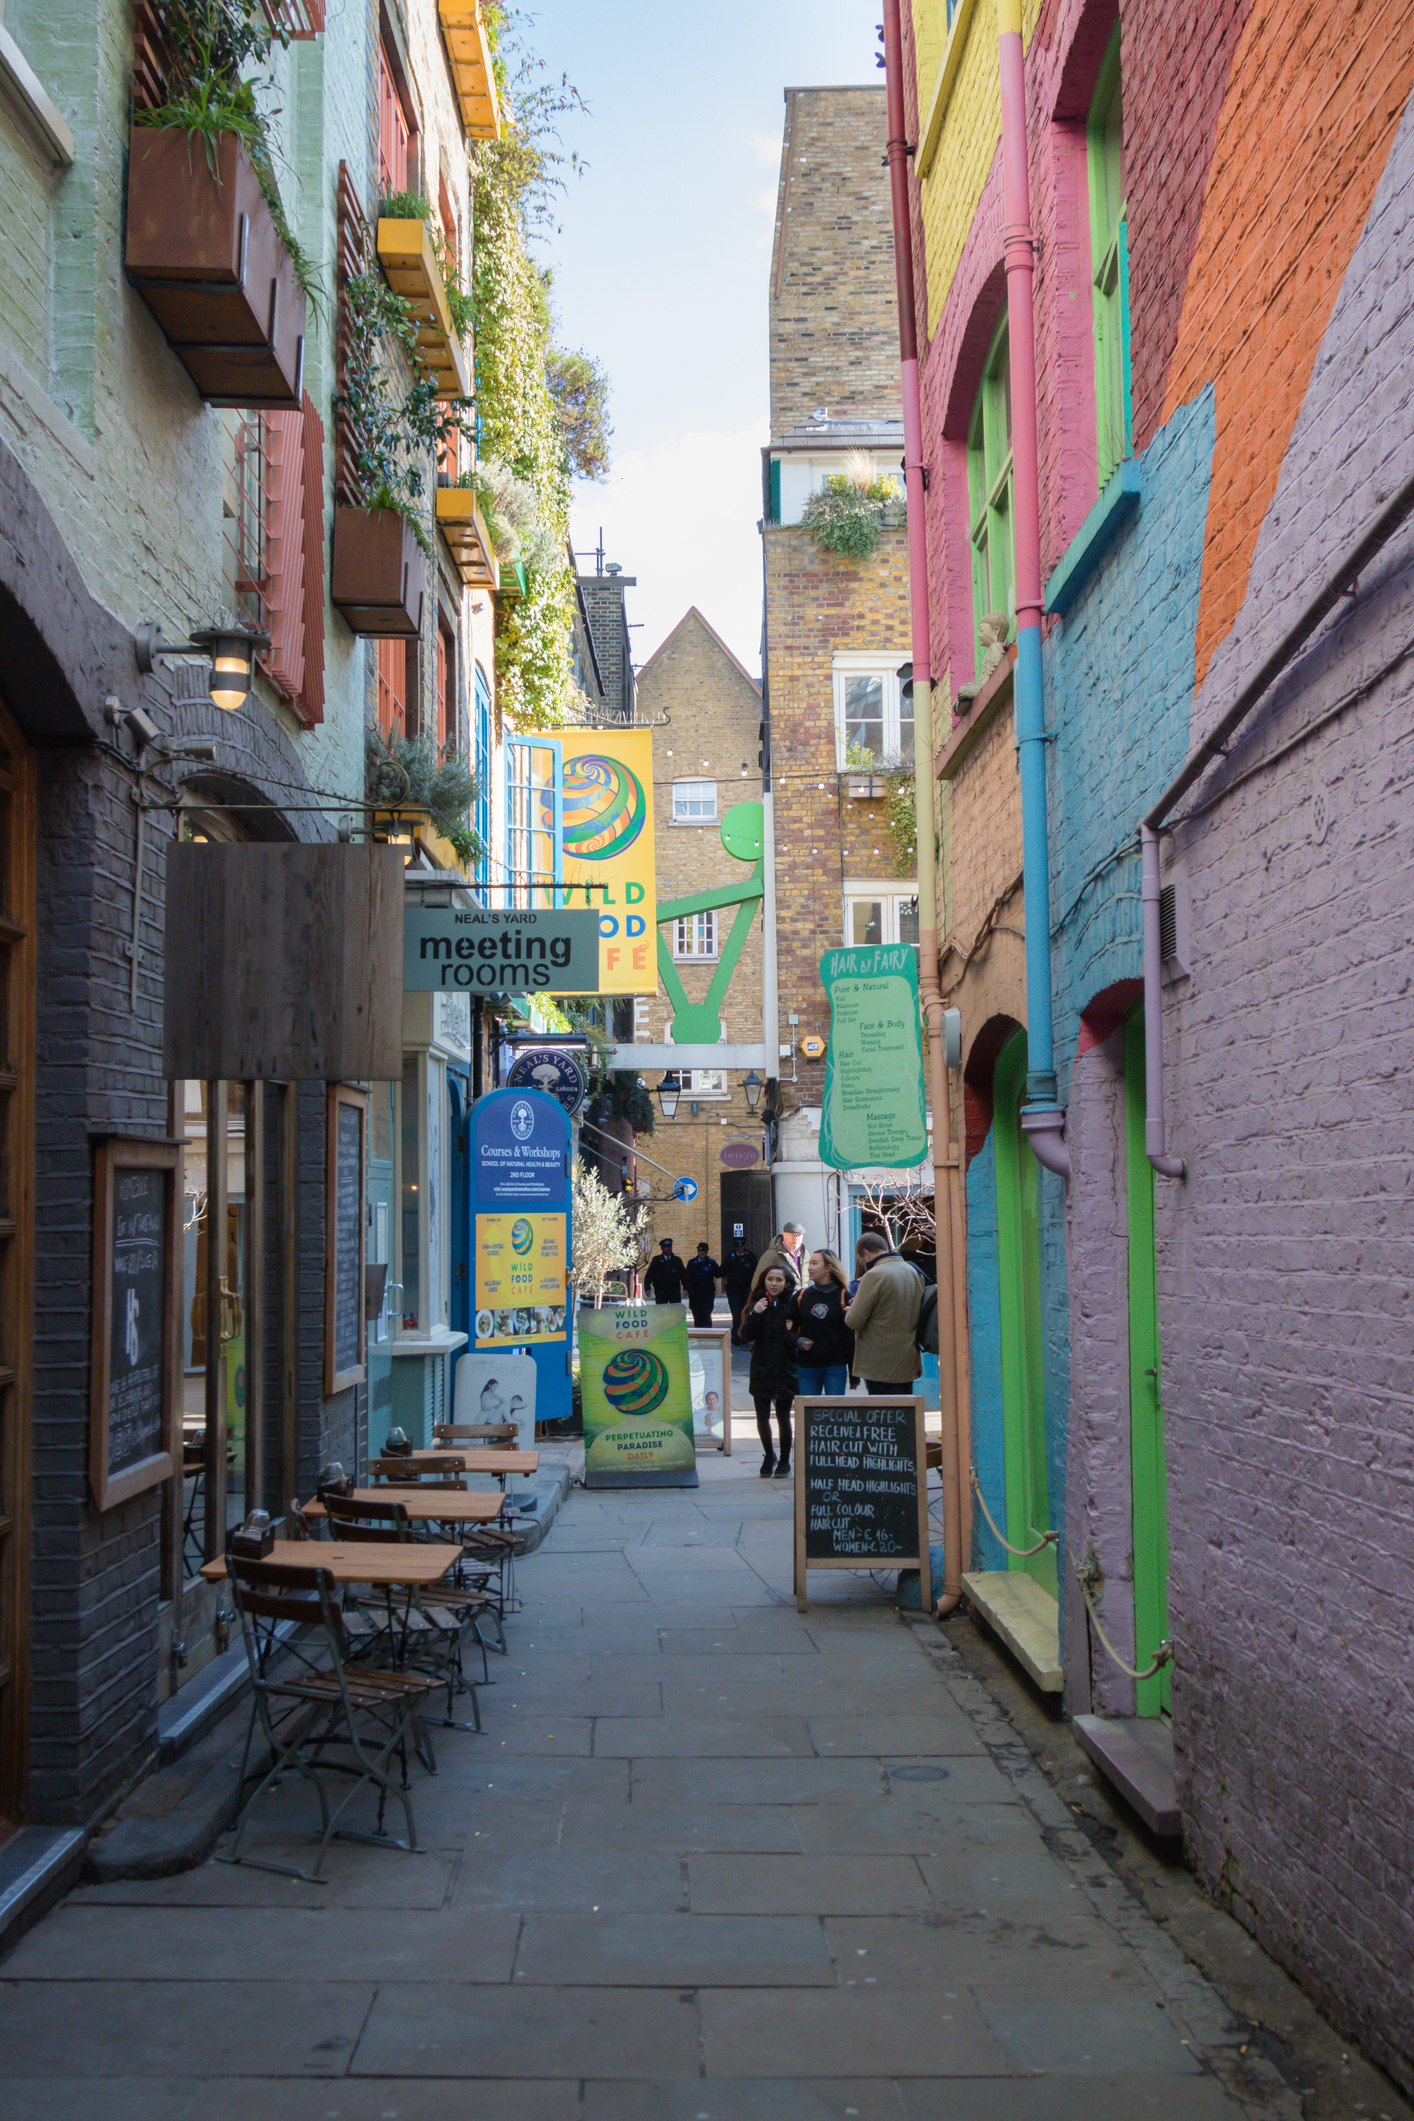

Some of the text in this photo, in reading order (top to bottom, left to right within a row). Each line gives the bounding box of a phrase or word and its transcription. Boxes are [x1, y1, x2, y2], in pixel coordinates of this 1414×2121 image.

[454, 913, 538, 924] NEAL'S YARD
[599, 914, 646, 938] OD
[420, 929, 571, 968] meeting
[830, 952, 858, 978] HAIR
[873, 948, 908, 974] FAIRY
[441, 962, 551, 987] rooms
[834, 981, 890, 994] Pure & Natural
[860, 1019, 905, 1031] Face & Body
[839, 1051, 854, 1059] Hair
[514, 1054, 578, 1083] NEAL'S YARD
[866, 1113, 896, 1121] Massage
[481, 1144, 561, 1160] Courses & Workshops
[511, 1274, 533, 1283] FOOD
[616, 1319, 648, 1329] FOOD
[866, 1410, 906, 1424] OFFER
[605, 1429, 674, 1442] PERPETUATING
[810, 1425, 856, 1439] RECEIVE
[863, 1426, 896, 1442] FREE
[617, 1440, 663, 1451] PARADISE
[810, 1439, 898, 1457] HAIR CUT WITH
[627, 1451, 654, 1461] DAILY
[810, 1478, 917, 1496] HALF HEAD HIGHLIGHTS
[822, 1491, 842, 1502] OR
[810, 1503, 875, 1518] FULL COLOUR
[810, 1518, 851, 1531] HAIR CUT
